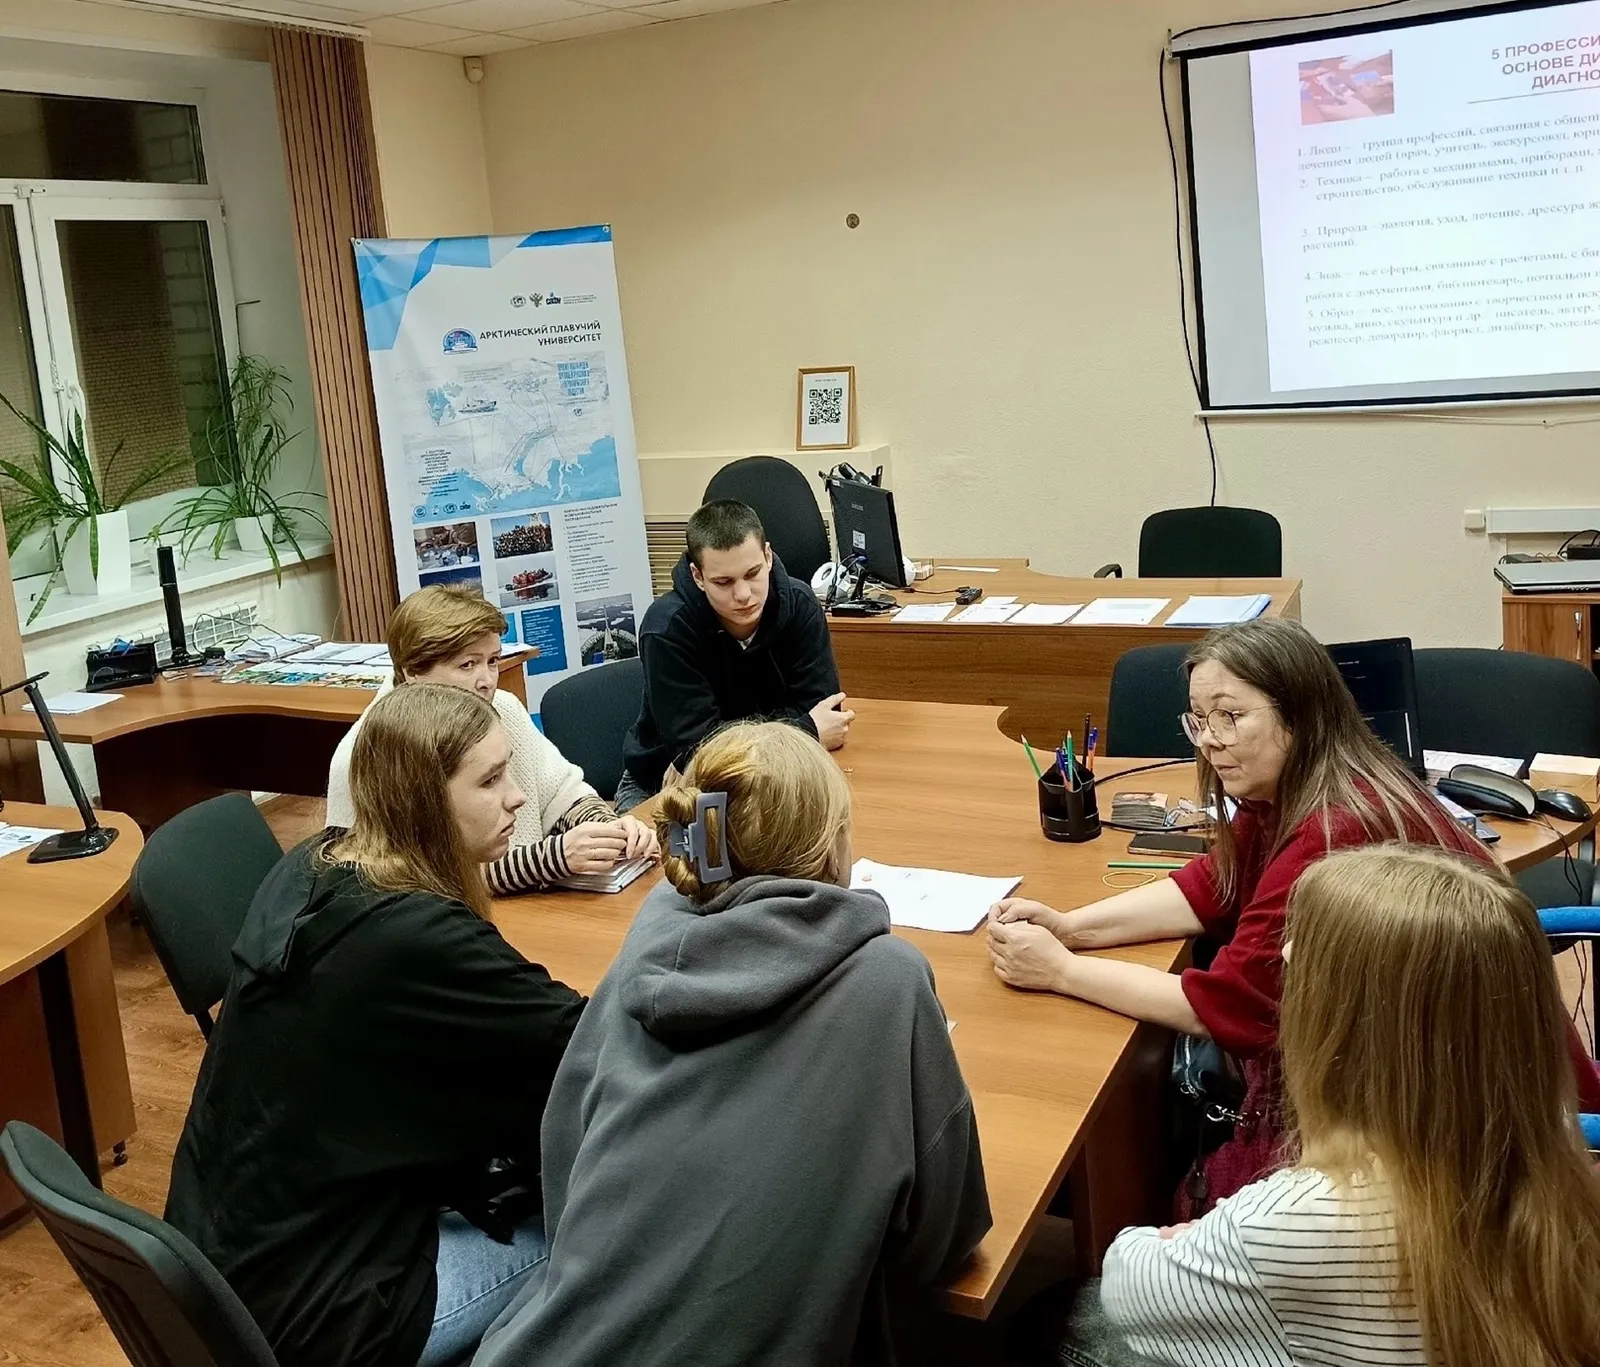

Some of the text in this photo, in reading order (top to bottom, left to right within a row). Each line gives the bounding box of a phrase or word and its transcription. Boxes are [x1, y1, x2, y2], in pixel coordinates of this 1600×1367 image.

[1491, 34, 1600, 60] 5 ПРОФЕССИ
[1502, 52, 1600, 75] ОСНОВЕ ДИ
[1531, 69, 1600, 90] ДИАГНО
[1309, 144, 1341, 157] Люди
[1362, 138, 1403, 152] группа
[1406, 128, 1476, 147] профессий,
[1479, 119, 1541, 136] связанная
[1543, 119, 1550, 127] с
[1298, 157, 1352, 171] лечением
[1355, 150, 1392, 165] людей
[1435, 142, 1487, 158] учитель,
[1491, 131, 1570, 148] экскурсовод,
[1316, 174, 1362, 187] Техника
[1379, 167, 1420, 182] работа
[1432, 157, 1517, 173] механизмами,
[1520, 148, 1594, 166] приборами,
[1315, 184, 1404, 202] строительство,
[1407, 173, 1494, 188] обслуживание
[1498, 167, 1548, 182] техники
[1317, 223, 1368, 238] Природа
[1472, 208, 1524, 222] лечение,
[1527, 202, 1585, 218] дрессура
[1315, 270, 1342, 281] Знак
[1305, 288, 1343, 303] работа
[1486, 292, 1562, 306] творчеством
[479, 320, 601, 340] АРКТИЧЕСКИЙ ПЛАВУЧИЙ
[537, 333, 602, 347] УНИВЕРСИТЕТ
